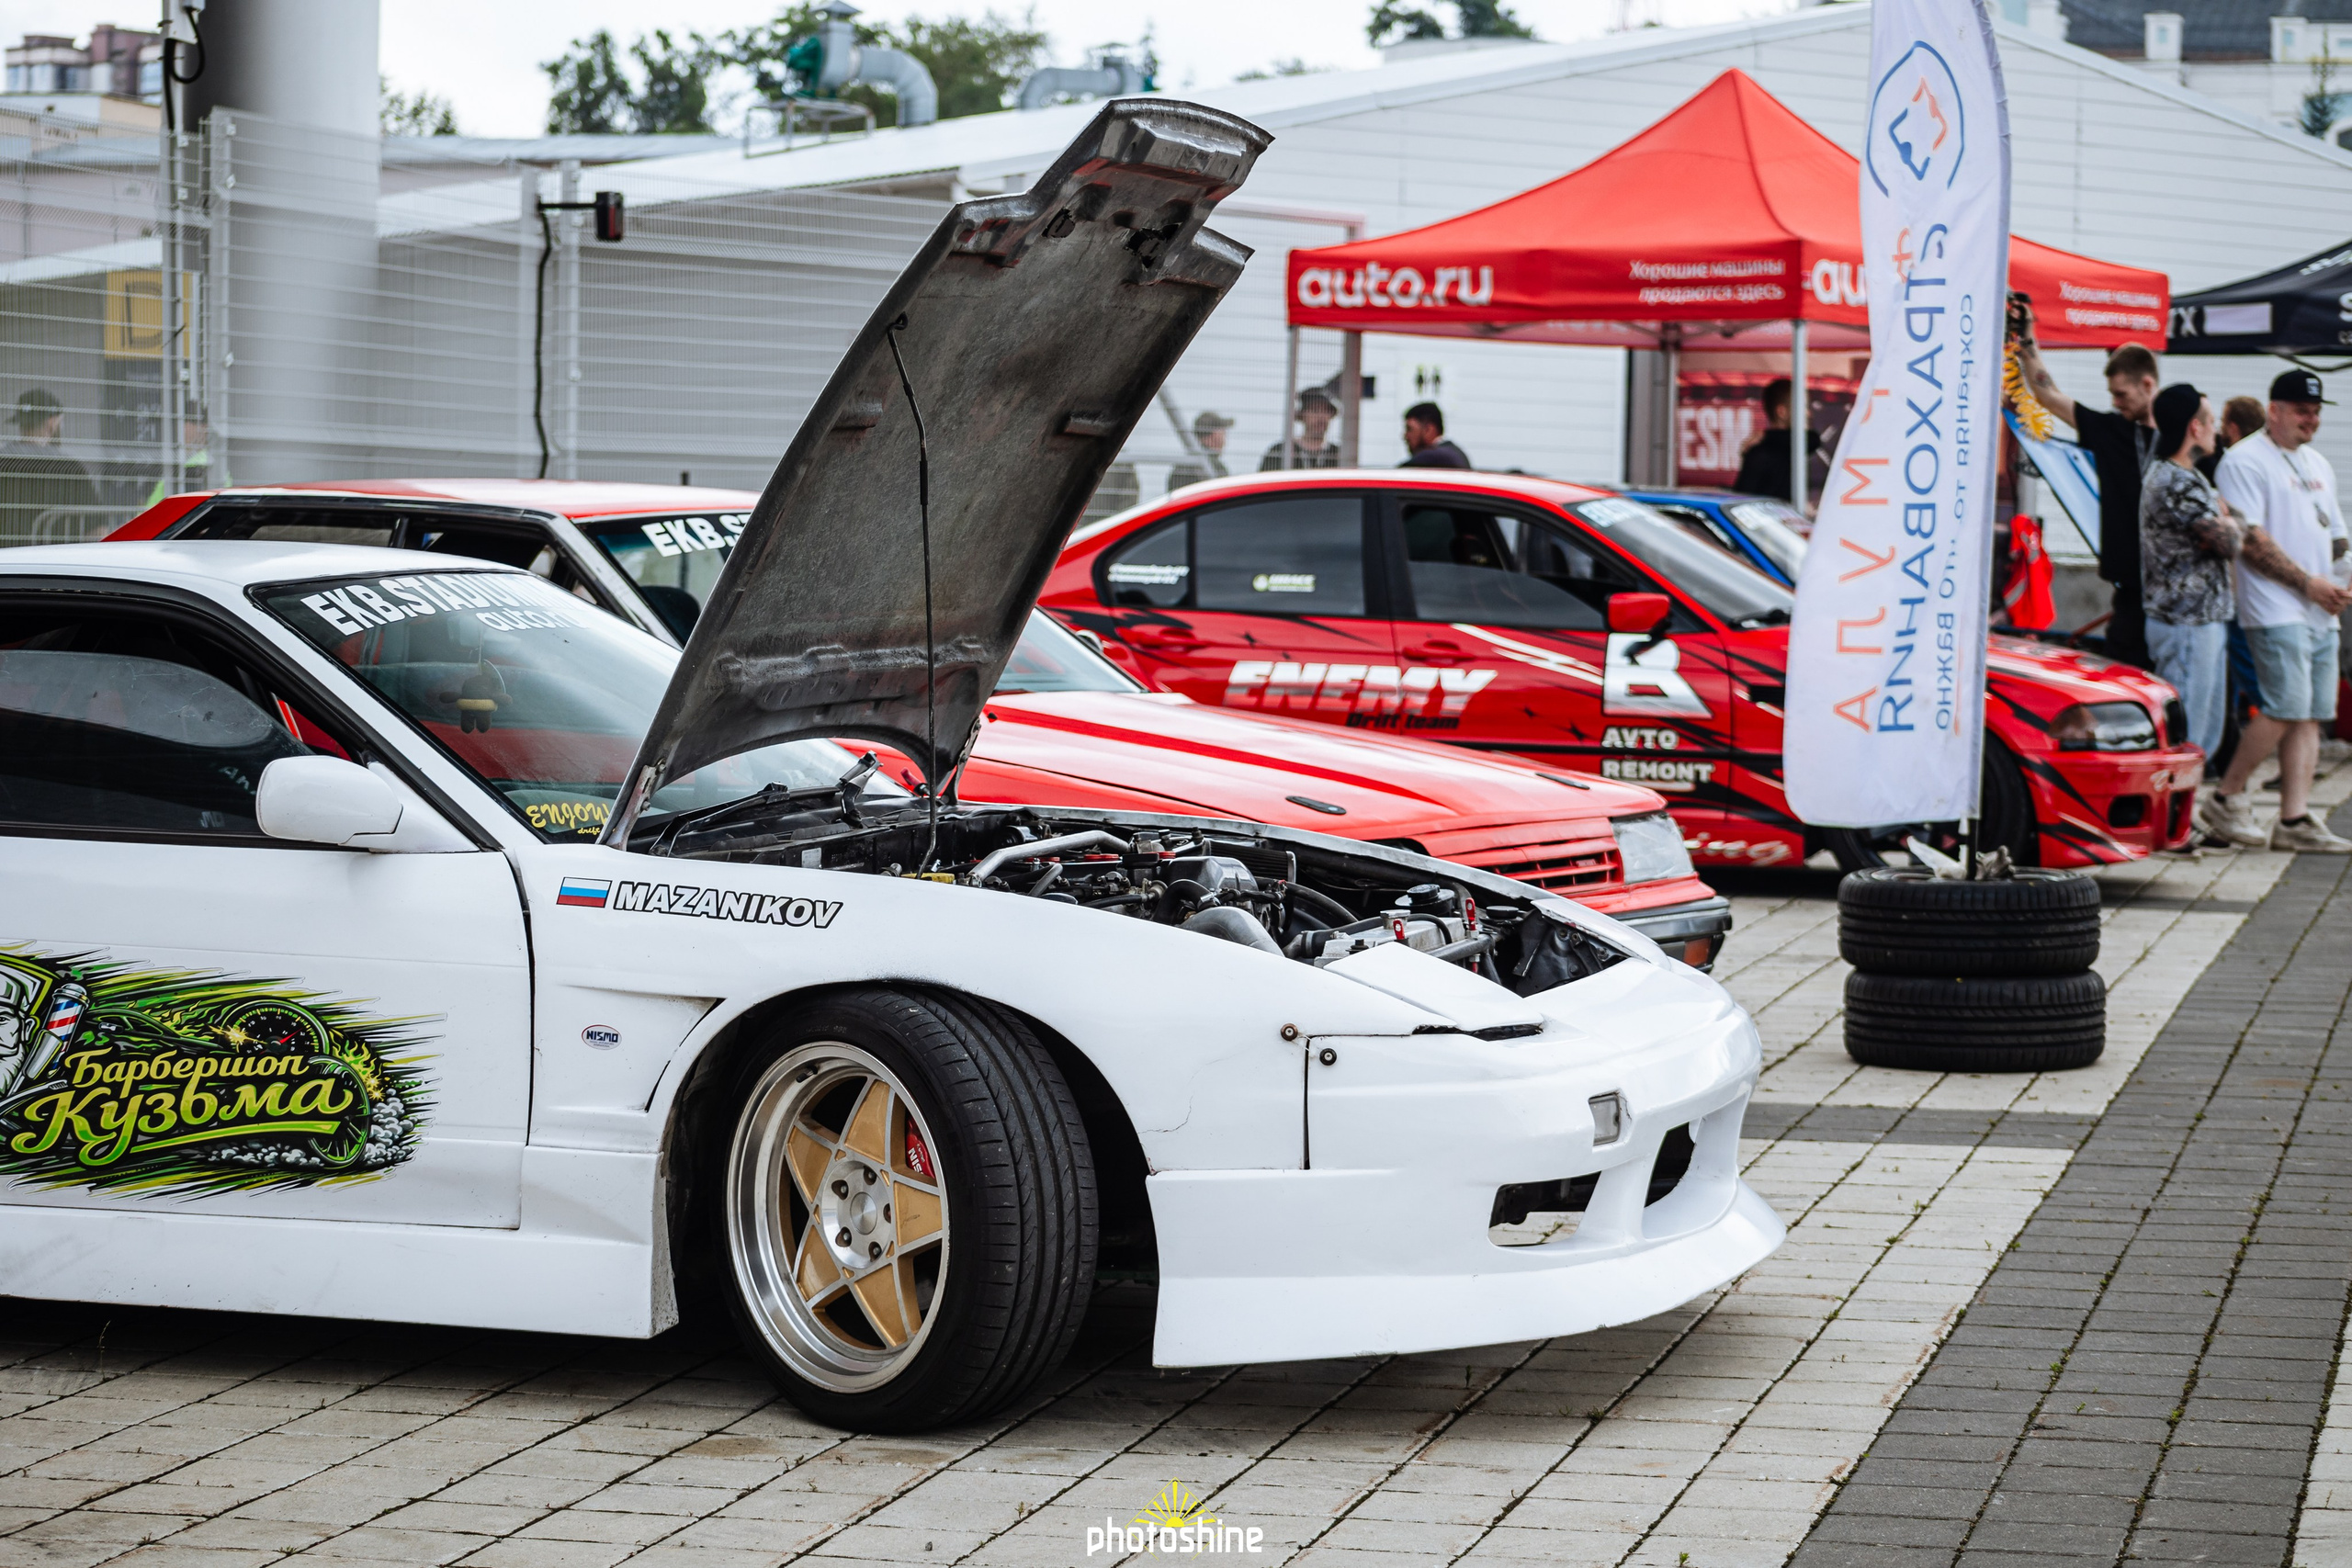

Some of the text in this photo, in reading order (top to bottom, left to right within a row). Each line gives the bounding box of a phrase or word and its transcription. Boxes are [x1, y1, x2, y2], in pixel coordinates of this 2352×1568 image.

[1297, 261, 1494, 308] auto.ru
[1629, 259, 1786, 283] Хорошие машины
[1639, 284, 1786, 306] продаются здесь
[640, 514, 752, 558] EKB.S
[1222, 660, 1498, 716] ENEMY
[1601, 727, 1679, 750] AVTO
[1601, 759, 1716, 784] REMONT
[614, 880, 844, 929] MAZANIKOV
[586, 1030, 619, 1043] NISMO
[63, 1045, 311, 1098] Барбершоп
[10, 1077, 355, 1167] Кузьма
